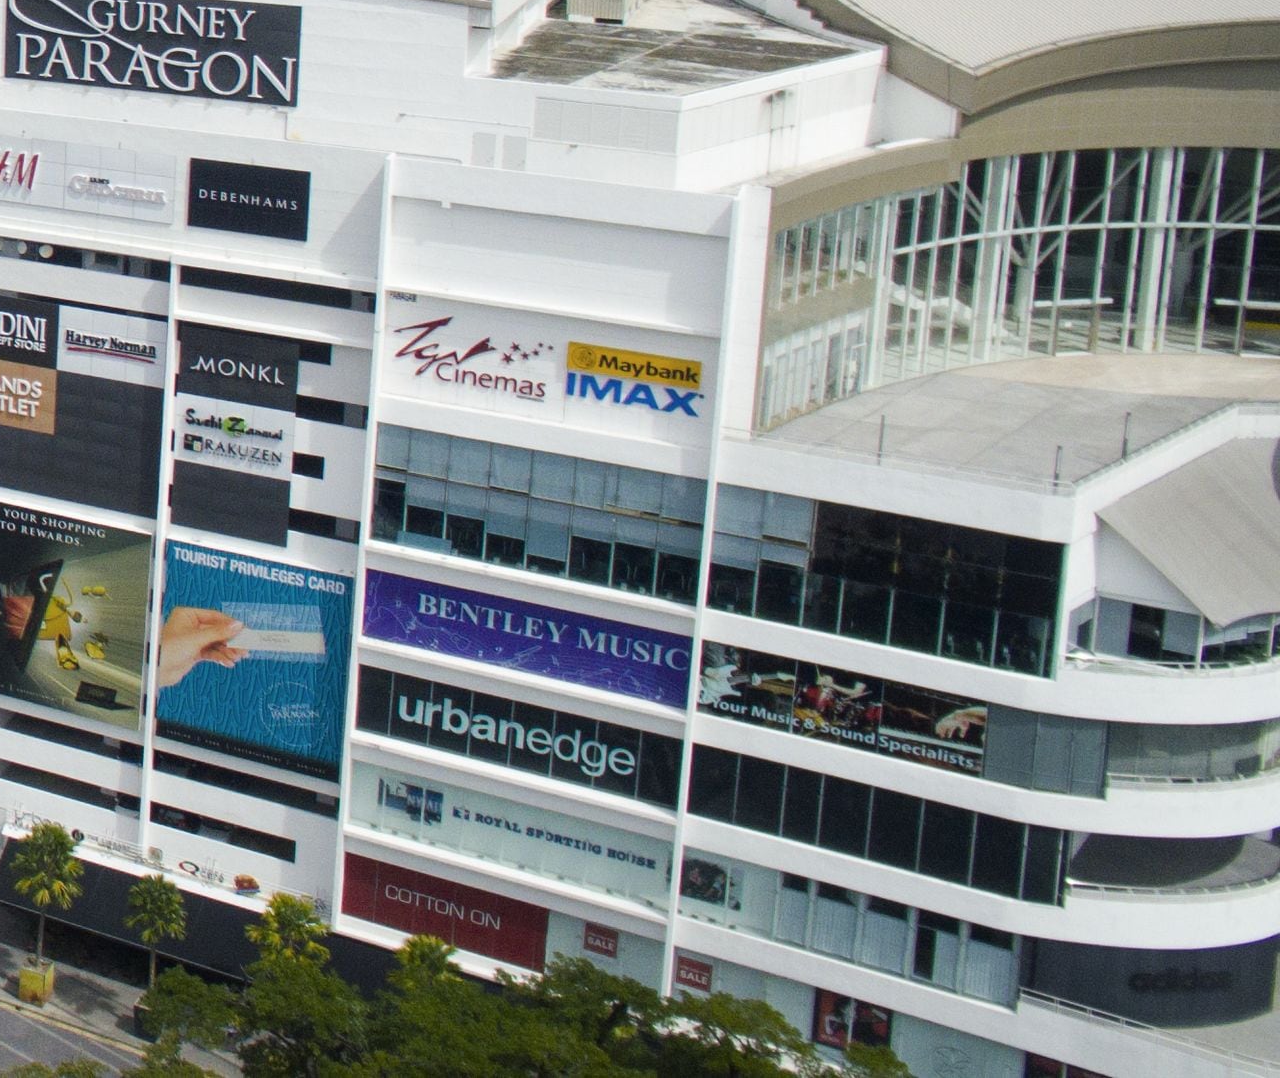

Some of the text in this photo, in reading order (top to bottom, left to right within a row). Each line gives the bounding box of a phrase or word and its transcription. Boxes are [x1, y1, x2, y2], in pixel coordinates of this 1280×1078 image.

[16, 32, 297, 103] PARAGON
[198, 188, 299, 211] DEBENHAMS
[13, 337, 46, 353] STORE
[65, 329, 156, 358] Harvey Norman
[435, 361, 547, 399] Cinemas
[598, 353, 699, 384] Maybank
[566, 372, 700, 417] IMAX
[205, 439, 282, 463] RAKUZEN
[3, 506, 39, 525] YOUR
[41, 515, 107, 539] SHOPPING
[19, 524, 84, 547] REWARDS.
[173, 545, 345, 596] TOURIST PRIVILEGES CARD
[418, 592, 691, 671] BENTLEY MUSIC
[398, 694, 636, 778] urbanedge
[711, 699, 975, 770] Your Music & Sound Specialists
[475, 813, 522, 833] ROYAL
[526, 827, 603, 855] SPORTING
[607, 848, 656, 870] HOUSE
[385, 883, 501, 931] COTTON ON
[587, 935, 614, 952] SALE
[679, 969, 708, 986] SALE
